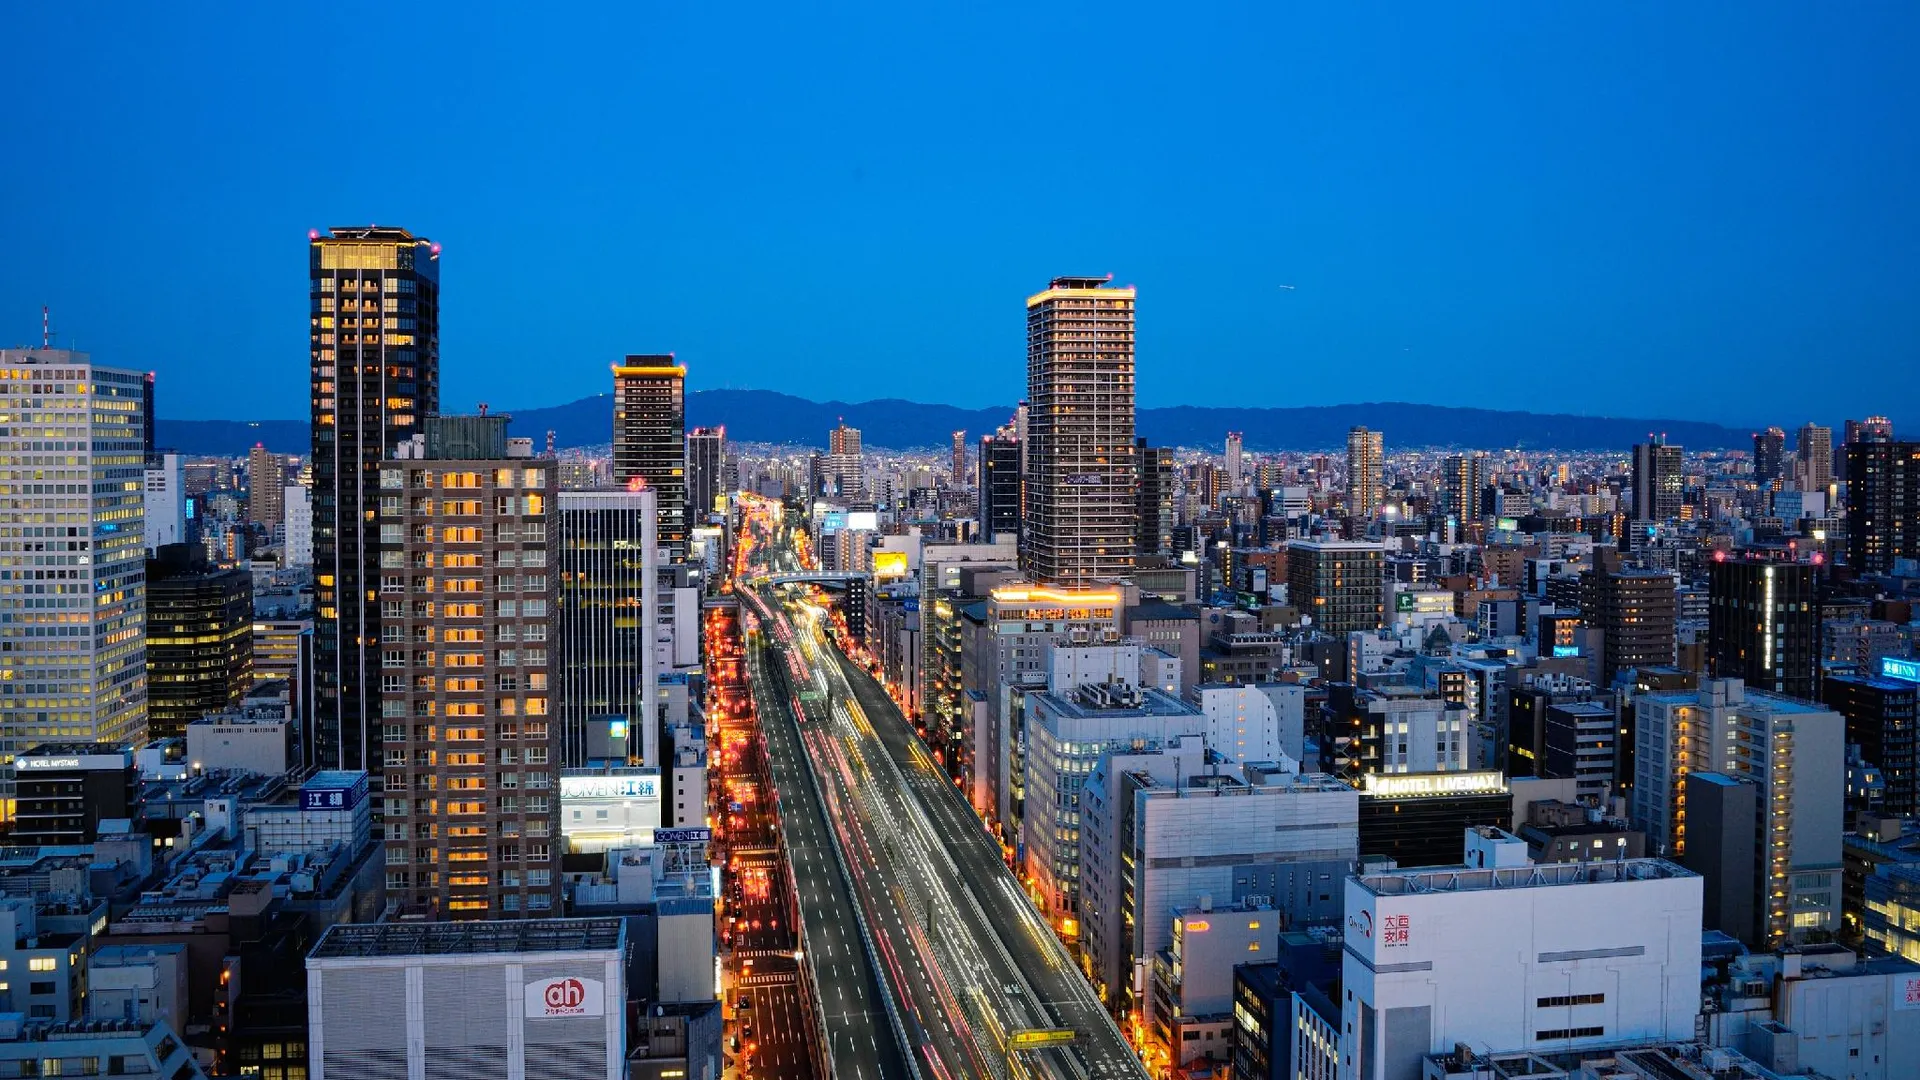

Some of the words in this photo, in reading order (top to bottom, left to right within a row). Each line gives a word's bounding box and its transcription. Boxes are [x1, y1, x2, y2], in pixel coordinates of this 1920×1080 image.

[30, 760, 50, 768] HOTEL
[51, 759, 79, 767] MYSTAYS
[1391, 778, 1432, 794] HOTEL
[1436, 775, 1495, 791] LIVEMAX
[656, 831, 690, 841] GOMEN
[547, 980, 580, 1005] ah
